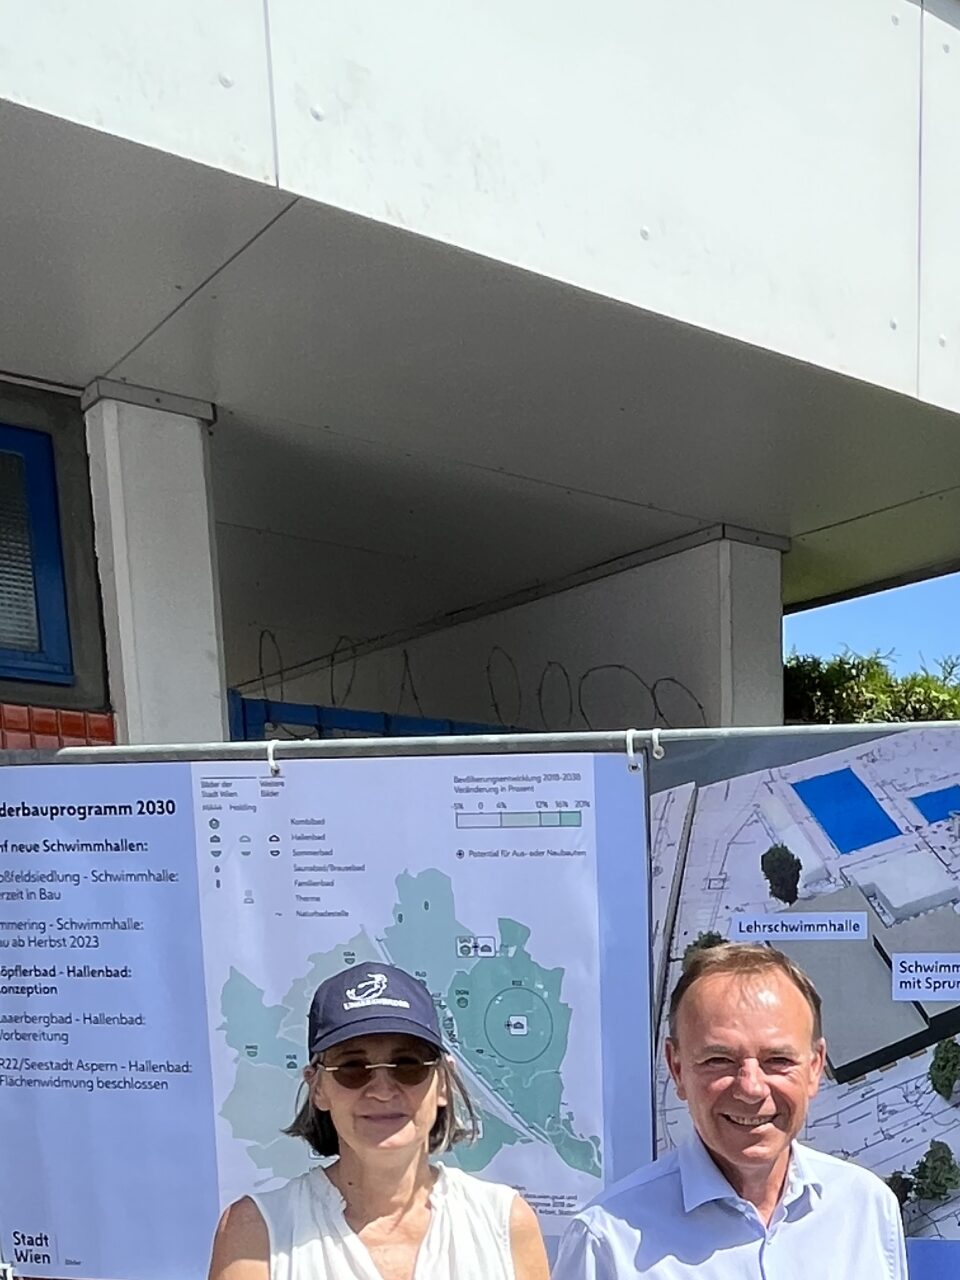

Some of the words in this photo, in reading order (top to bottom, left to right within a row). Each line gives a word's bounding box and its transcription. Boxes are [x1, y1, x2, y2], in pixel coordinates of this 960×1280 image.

[0, 801, 132, 820] derbauprogramm
[137, 800, 176, 815] 2030
[11, 843, 39, 852] neue
[43, 839, 148, 852] Schwimmhallen:
[91, 869, 179, 883] Schwimmhalle:
[27, 888, 37, 900] in
[39, 887, 61, 900] Bau
[56, 918, 144, 931] Schwimmhalle:
[738, 920, 861, 933] Lehrschwimmhalle
[12, 936, 26, 948] ab
[28, 935, 67, 948] Herbst
[70, 935, 100, 948] 2023
[67, 965, 132, 978] Hallenbad:
[0, 983, 58, 997] onzeption
[899, 977, 923, 990] mit
[83, 1013, 146, 1026] Hallenbad:
[76, 1059, 118, 1074] Aspern
[128, 1060, 193, 1074] Hallenbad:
[0, 1074, 94, 1092] Flächenwidmung
[96, 1077, 169, 1091] beschlossen
[13, 1231, 49, 1246] Stadt
[14, 1248, 51, 1265] Wien
